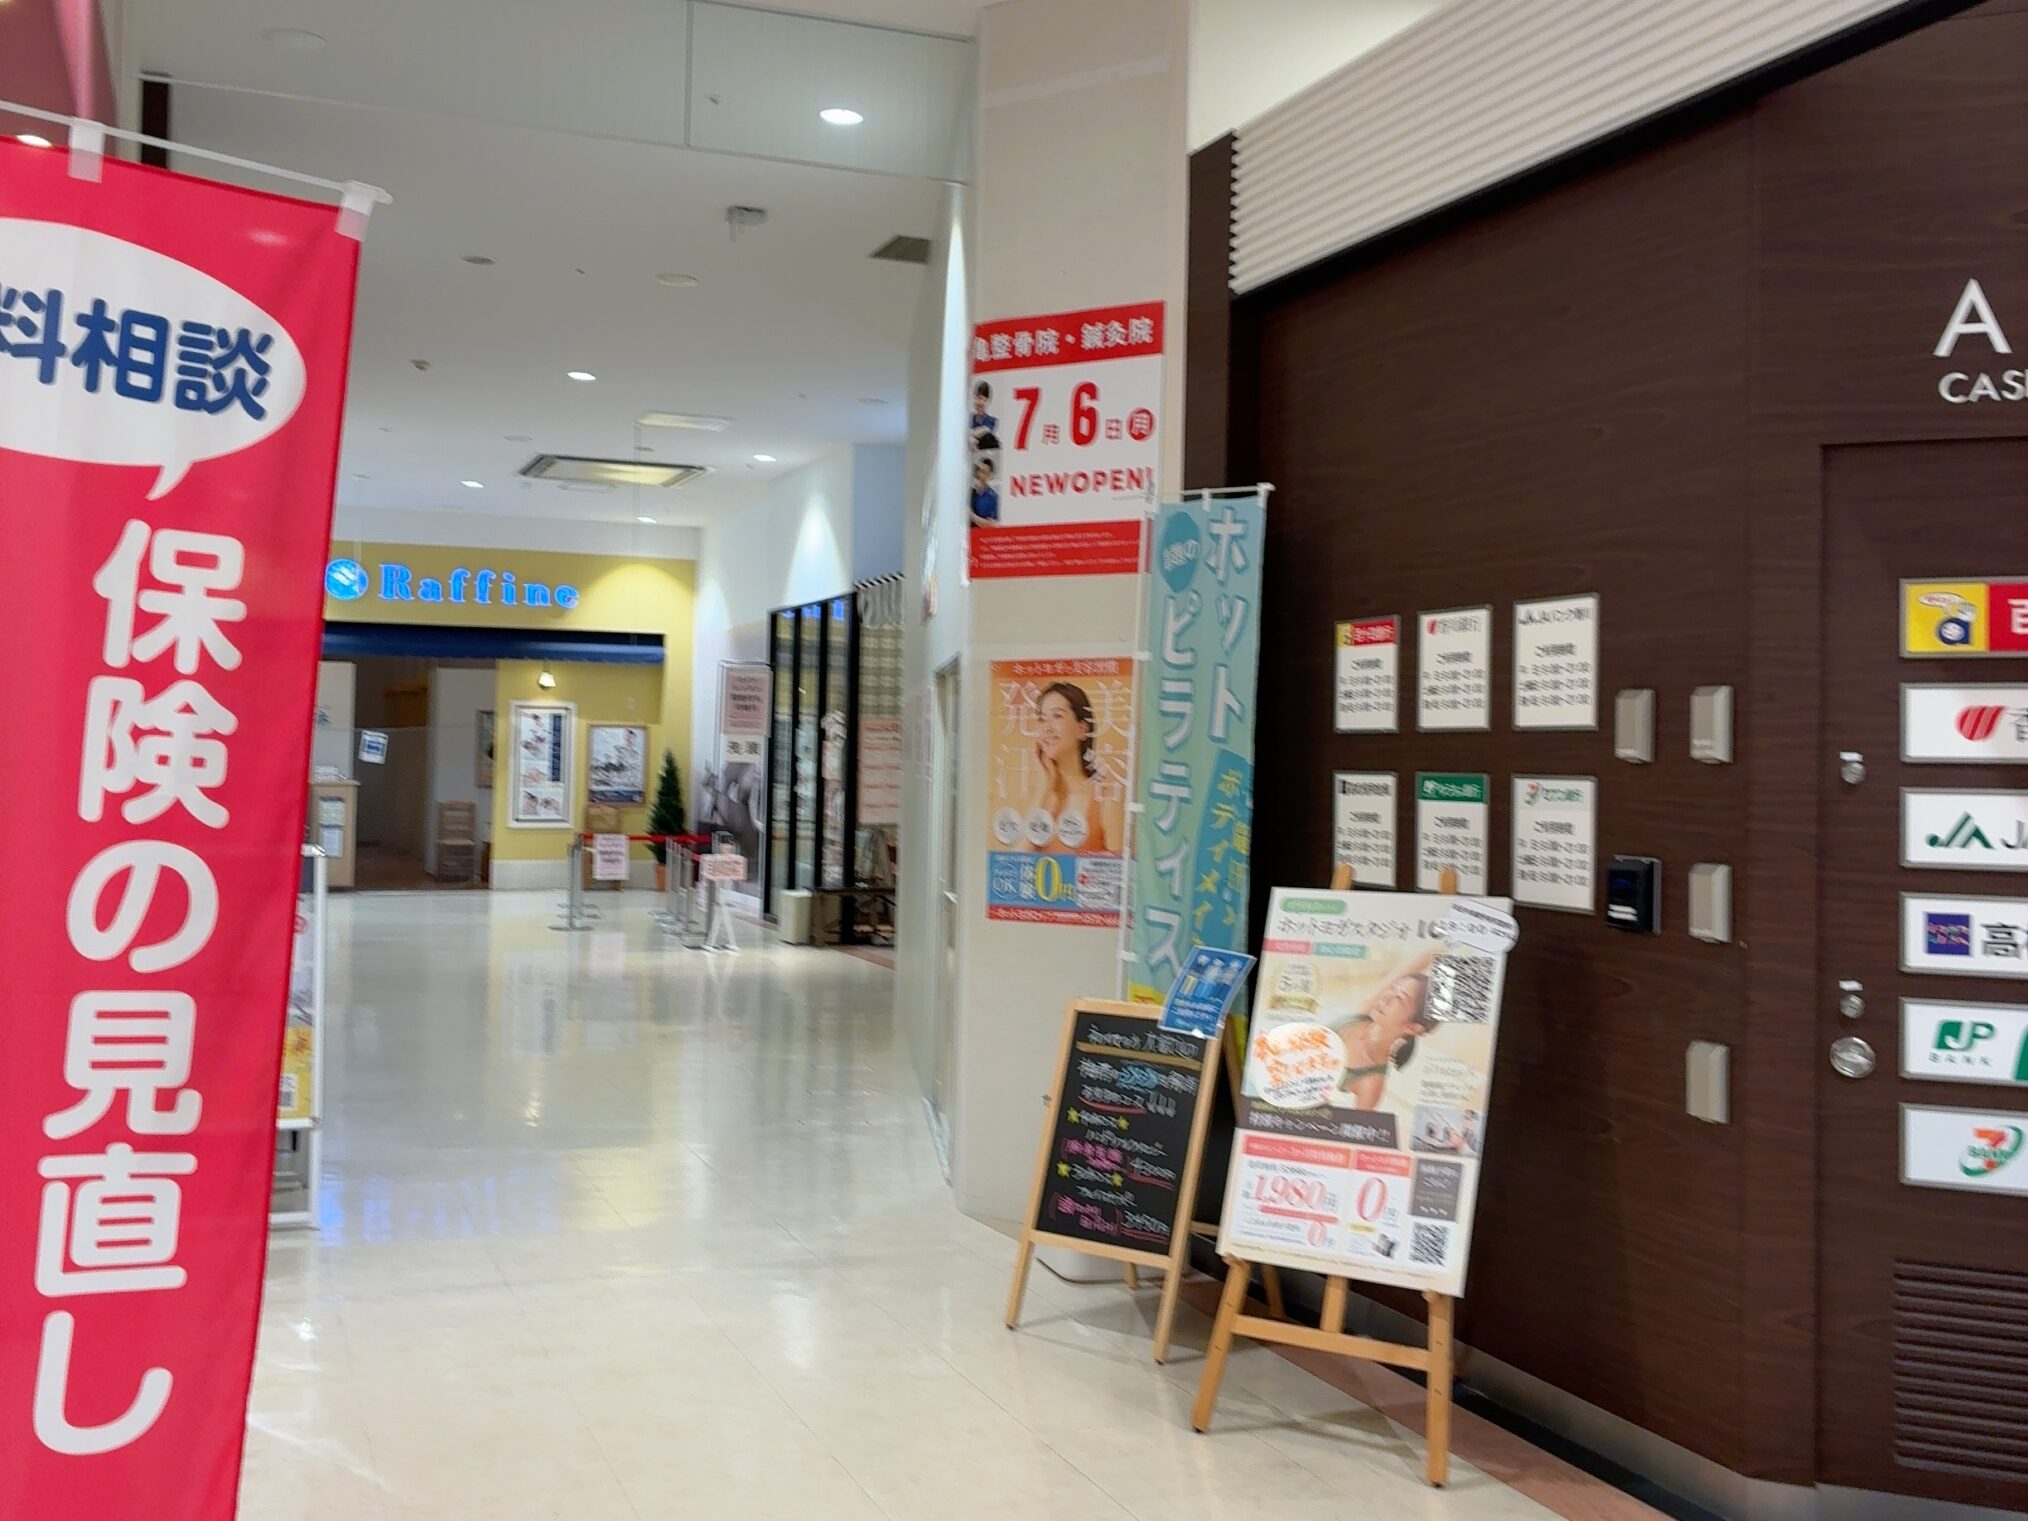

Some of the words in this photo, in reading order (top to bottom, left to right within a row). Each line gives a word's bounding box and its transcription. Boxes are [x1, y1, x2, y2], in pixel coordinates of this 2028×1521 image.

[1937, 368, 2028, 404] CAS
[378, 563, 581, 609] Raffine
[1204, 504, 1248, 745] ホット
[33, 519, 250, 1456] 保険の見直し
